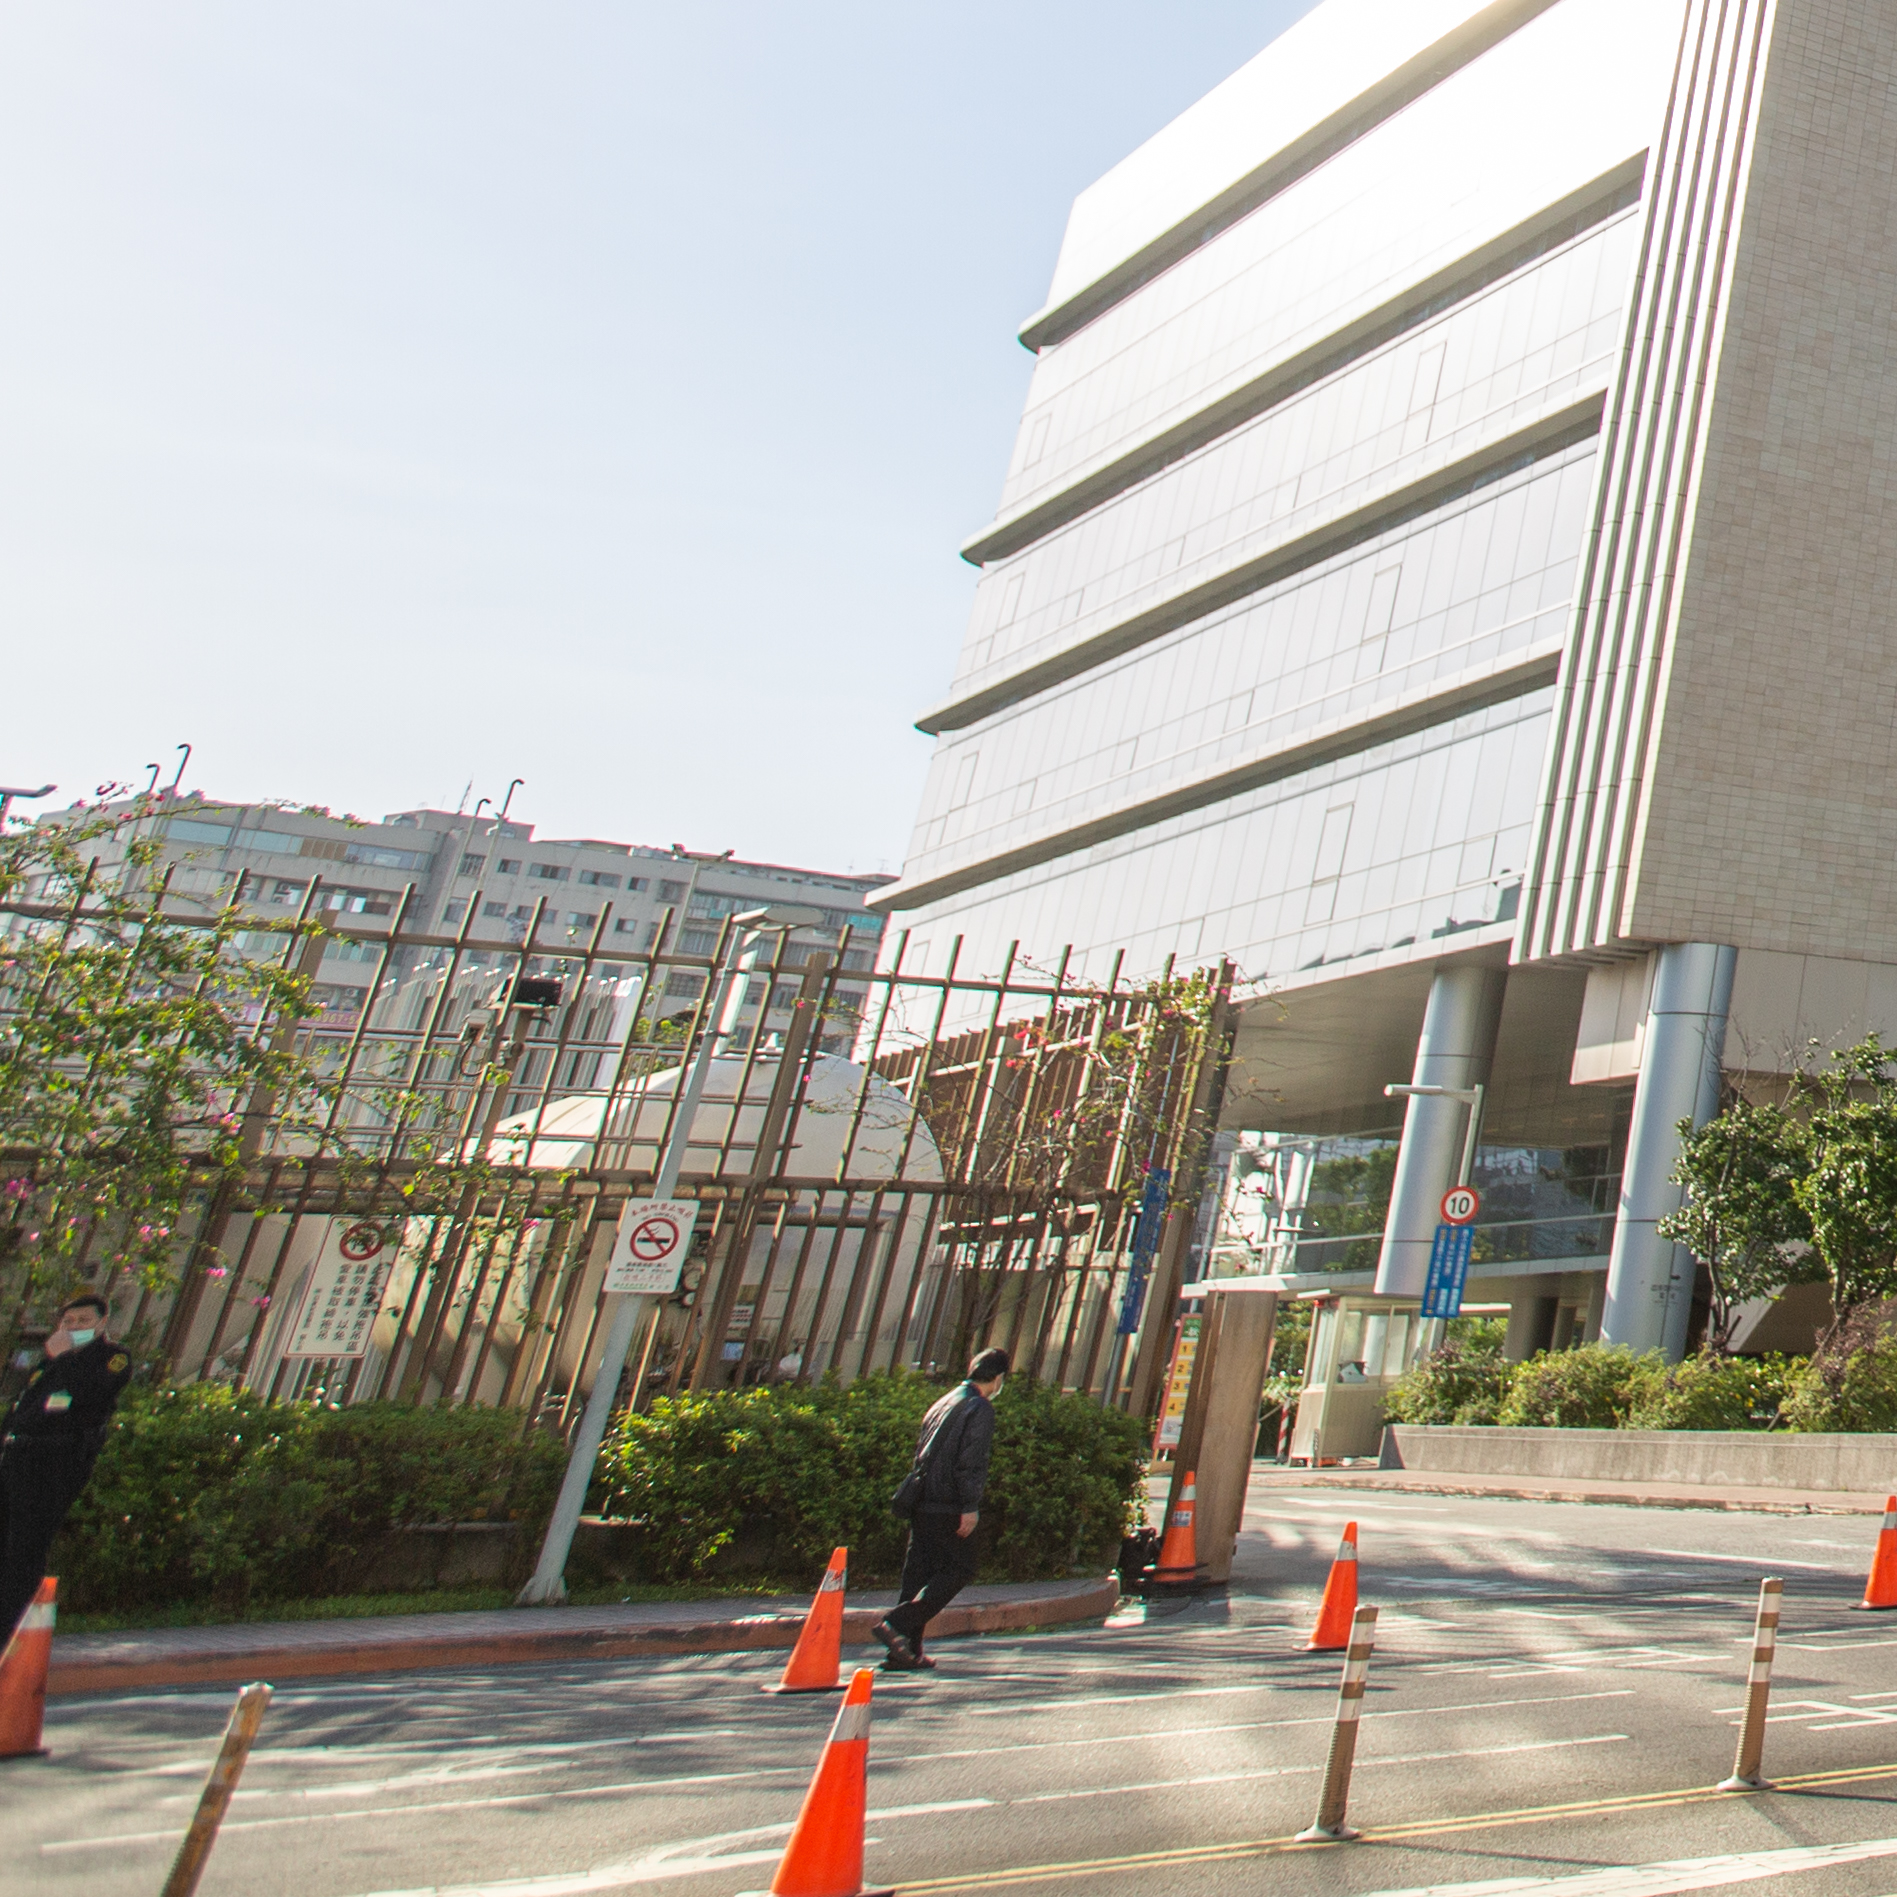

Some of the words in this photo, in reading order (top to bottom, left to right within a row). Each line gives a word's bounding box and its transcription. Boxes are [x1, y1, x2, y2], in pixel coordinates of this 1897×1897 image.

[1451, 1196, 1470, 1214] 10
[1178, 1364, 1184, 1373] 2
[1174, 1382, 1180, 1390] 3
